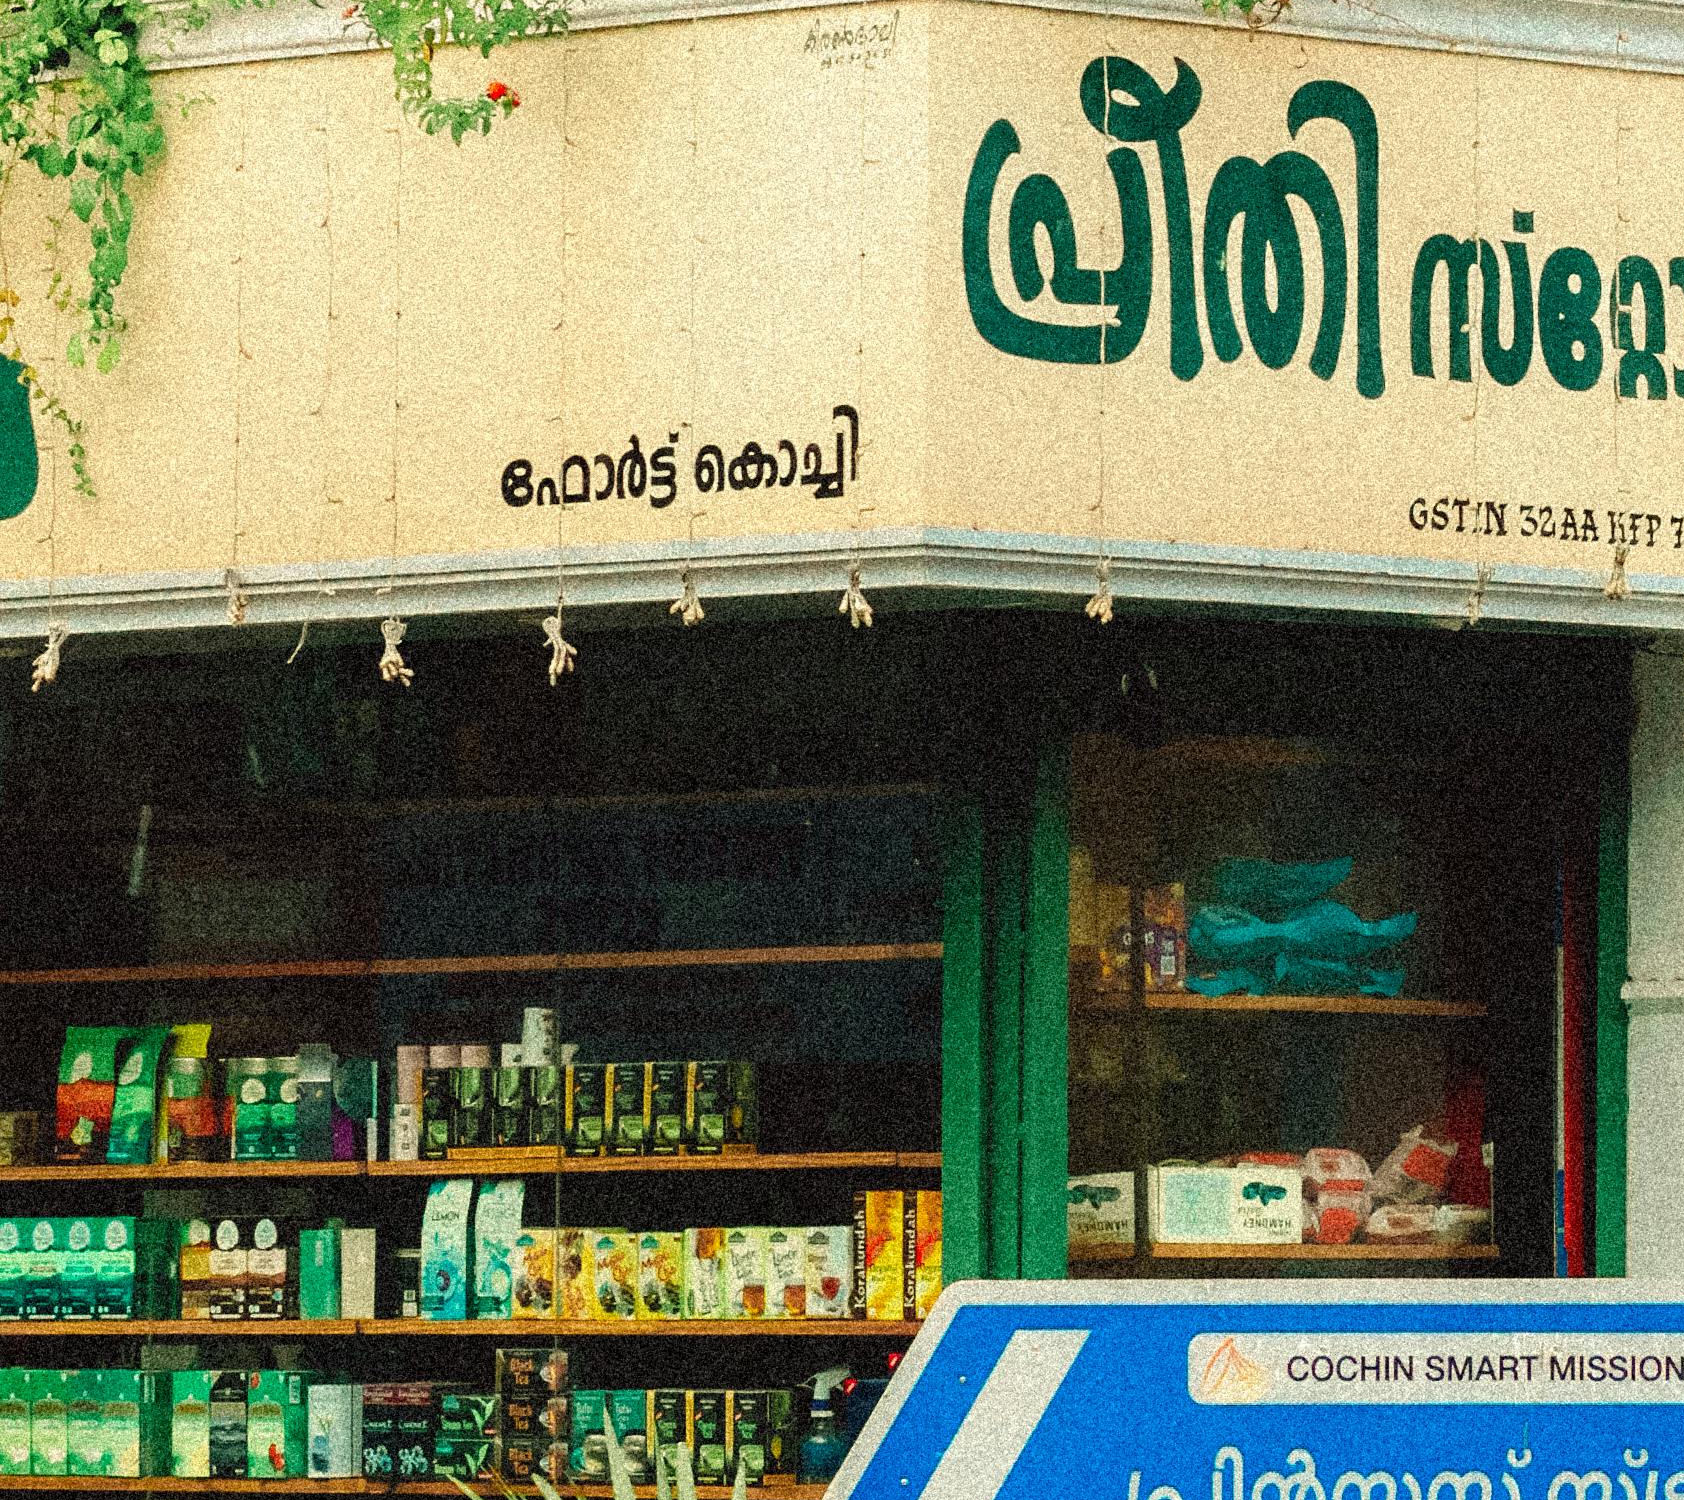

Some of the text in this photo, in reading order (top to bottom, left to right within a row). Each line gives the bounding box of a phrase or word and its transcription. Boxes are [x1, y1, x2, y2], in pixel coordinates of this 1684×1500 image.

[962, 55, 1386, 400] പ്രീതി
[501, 404, 860, 509] ഫോർട്ട് കൊച്ചി
[1408, 496, 1509, 537] GSTIN
[1519, 504, 1600, 544] 32AA
[854, 1210, 867, 1309] Korakundah
[904, 1209, 917, 1308] Korakundah
[1286, 1355, 1415, 1382] COCHIN
[1425, 1355, 1538, 1381] SMART
